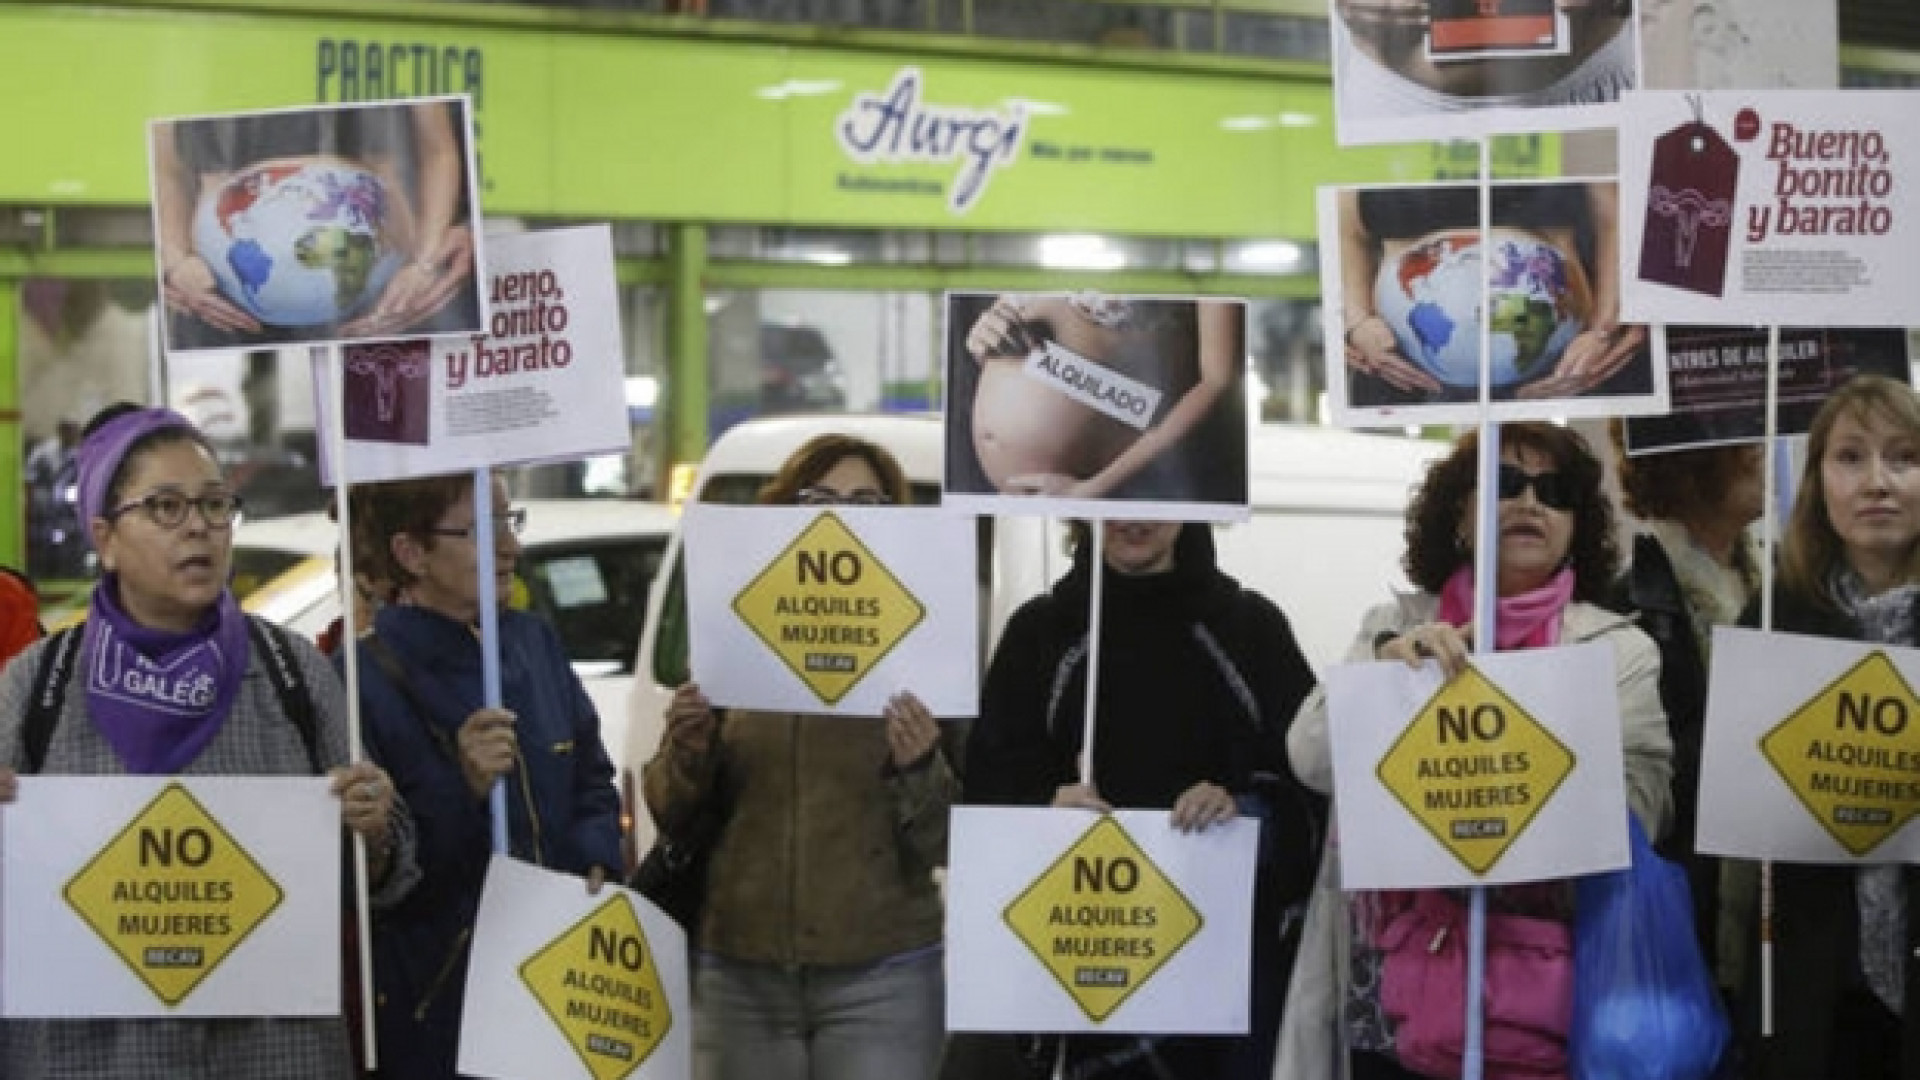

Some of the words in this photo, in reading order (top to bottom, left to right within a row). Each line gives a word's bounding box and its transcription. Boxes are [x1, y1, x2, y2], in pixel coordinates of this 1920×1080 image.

[843, 74, 1022, 208] Aurgi
[1765, 122, 1890, 166] Bueno,
[1775, 161, 1893, 199] bonito
[1746, 205, 1771, 243] y
[1775, 198, 1893, 235] barato
[473, 302, 568, 340] onito
[446, 351, 468, 390] y
[474, 335, 573, 378] barato
[1669, 347, 1720, 369] NTRES
[1037, 355, 1147, 417] ALQUILADO
[797, 550, 862, 586] NO
[775, 595, 881, 619] ALQUILES
[781, 625, 880, 646] MUJERES
[1437, 705, 1506, 744] NO
[1835, 691, 1909, 734] NO
[1418, 752, 1530, 779] ALQUILES
[1424, 783, 1531, 810] MUJERES
[139, 827, 214, 867] NO
[112, 880, 233, 904] ALQUILES
[1073, 856, 1140, 894] NO
[117, 914, 232, 935] MUJERES
[1049, 905, 1157, 927] ALQUILES
[588, 925, 642, 972] NO
[1053, 937, 1155, 958] MUJERES
[562, 968, 652, 1011] ALQUILES
[567, 999, 651, 1037] MUJERES
